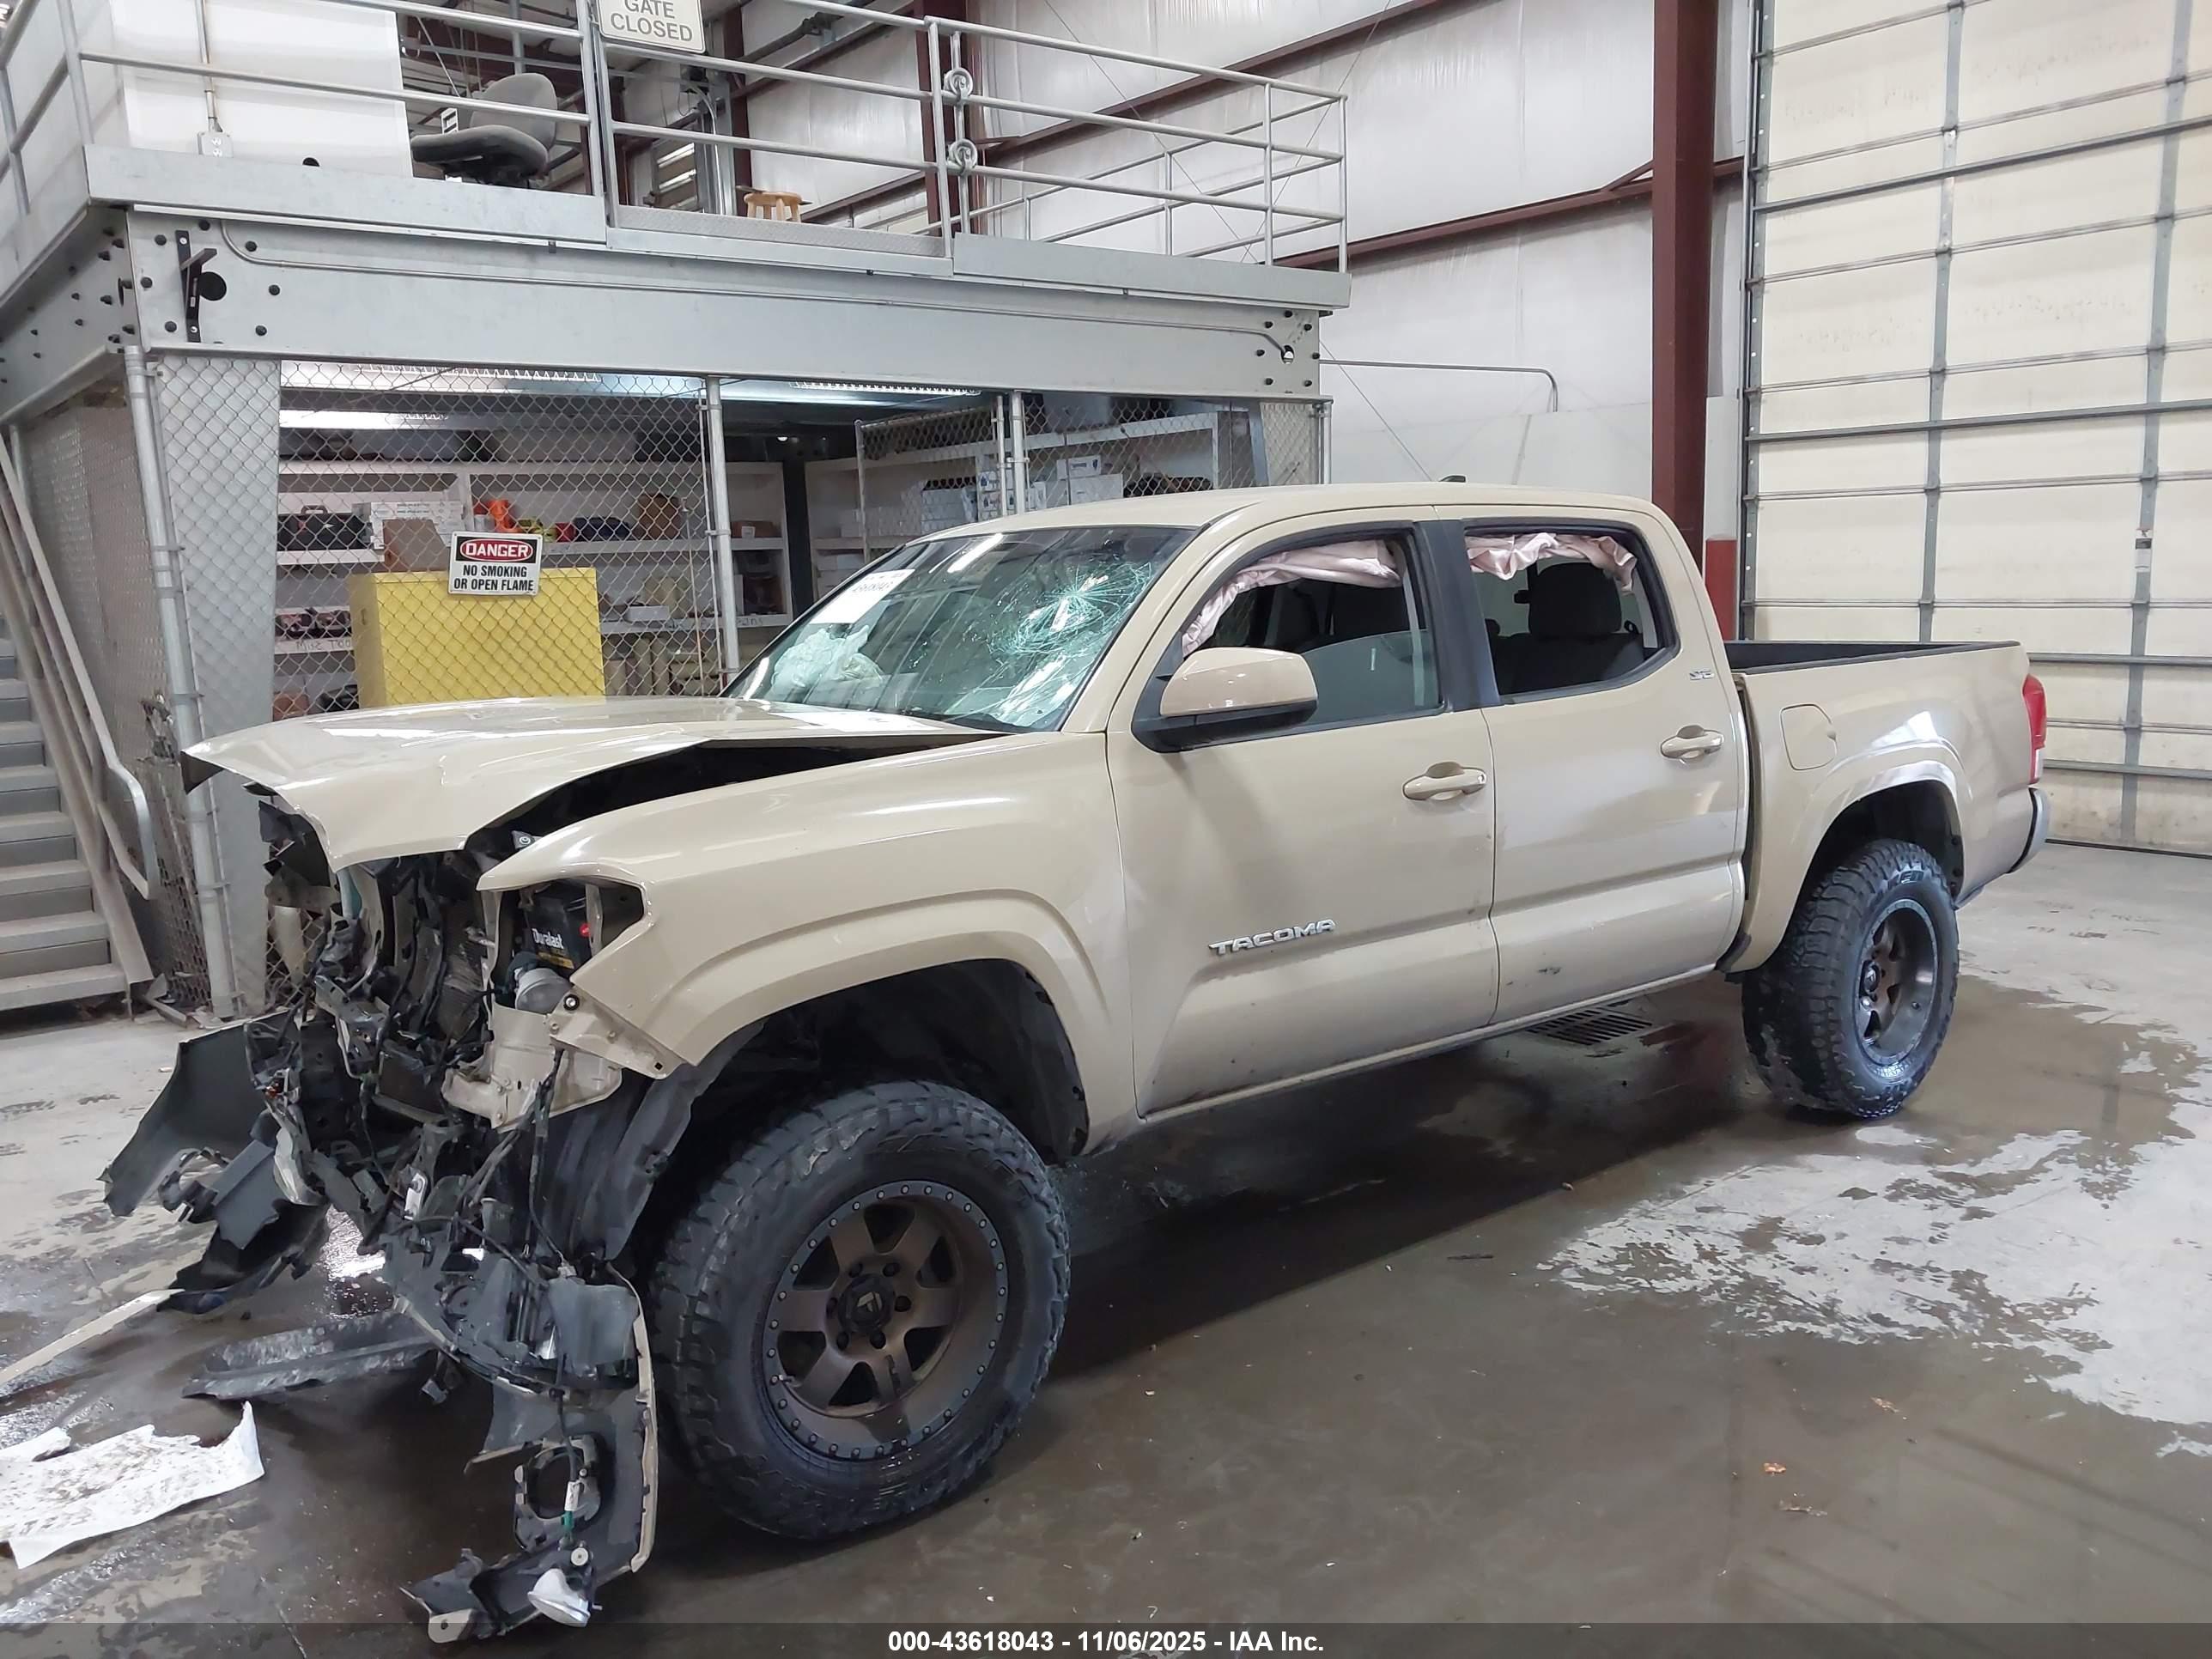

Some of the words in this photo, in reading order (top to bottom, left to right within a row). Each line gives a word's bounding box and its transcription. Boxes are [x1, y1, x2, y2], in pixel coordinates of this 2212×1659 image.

[624, 0, 675, 19] GATE
[611, 12, 693, 42] CLOSED
[465, 543, 529, 557] DANGER
[463, 565, 477, 576] NO
[481, 565, 527, 578] SMOKING
[453, 577, 467, 590] OR
[471, 579, 498, 591] OPEN
[501, 580, 534, 592] FLAME
[532, 927, 564, 950] Duralast
[1208, 919, 1336, 956] TACOMA
